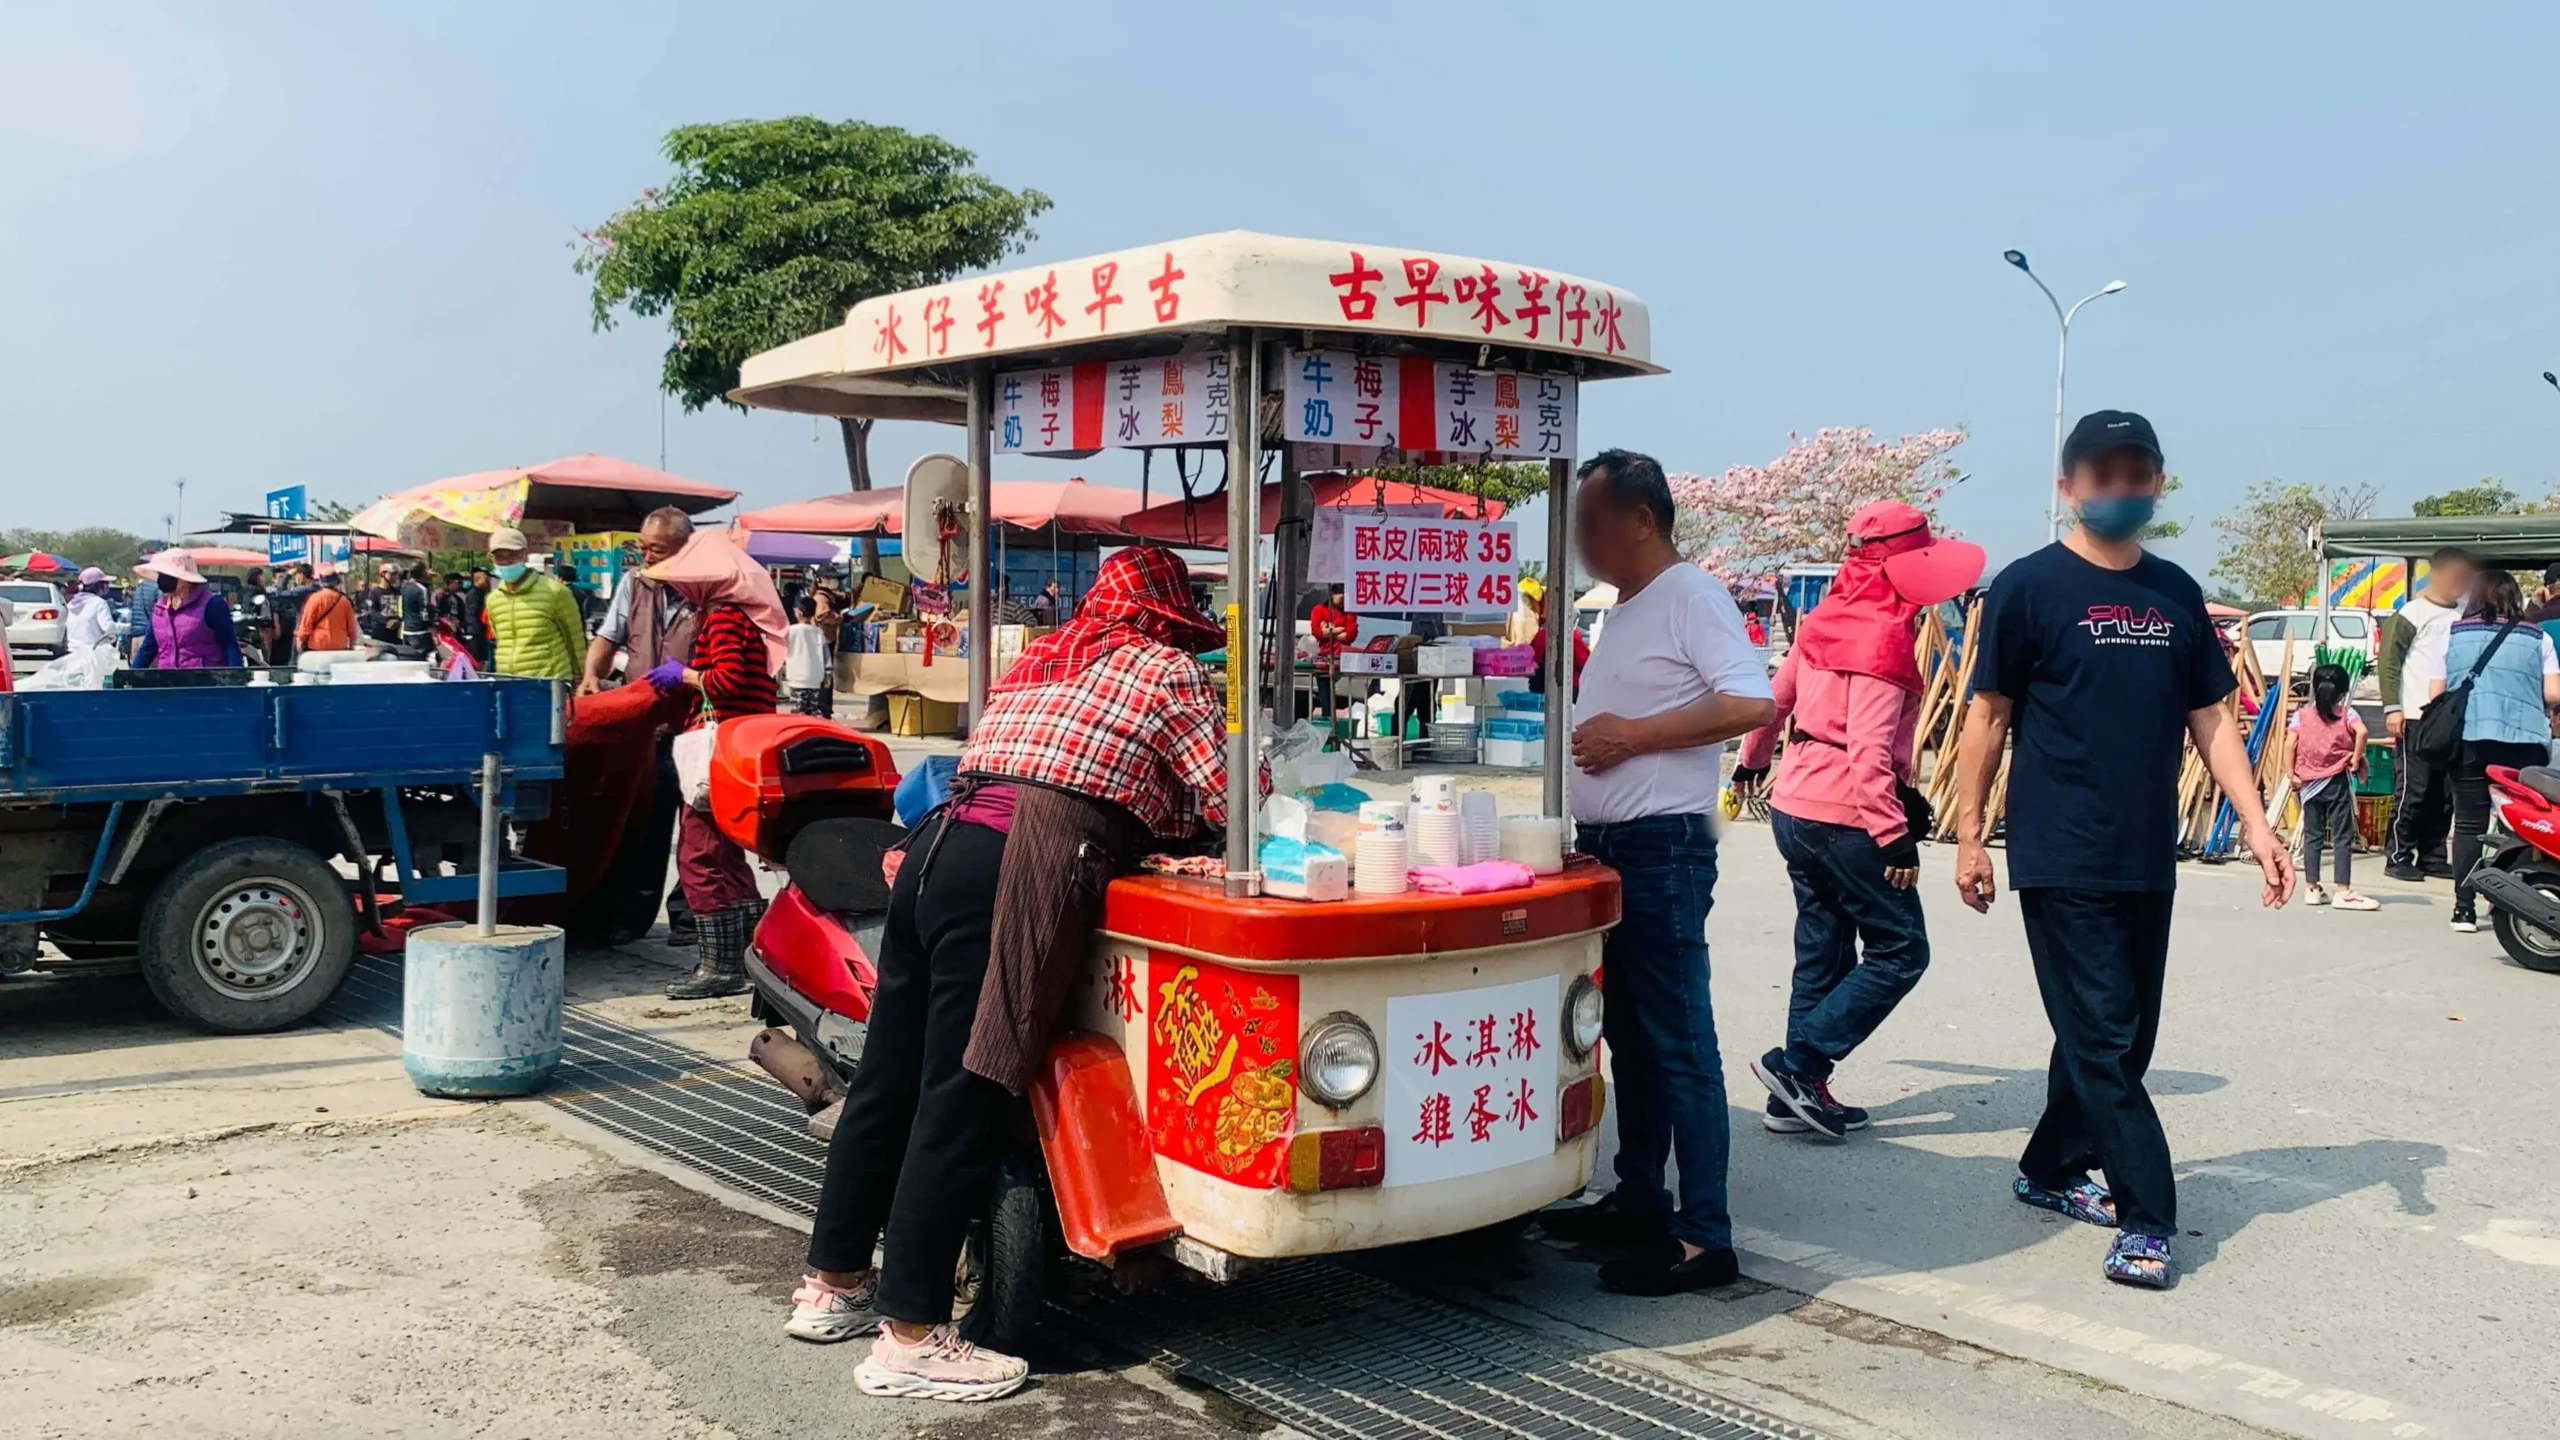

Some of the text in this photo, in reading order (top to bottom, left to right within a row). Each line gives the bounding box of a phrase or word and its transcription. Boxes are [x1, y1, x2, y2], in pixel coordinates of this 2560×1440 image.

[1329, 251, 1626, 354] 古早味芋仔冰
[1003, 376, 1023, 449] 牛奶
[1040, 373, 1061, 447] 梅子
[1118, 364, 1141, 441] 芋冰
[1161, 359, 1184, 439] 鳳梨
[1205, 354, 1229, 437] 巧克力
[1303, 355, 1334, 438] 牛奶
[1353, 360, 1384, 441] 梅子
[1449, 368, 1477, 447] 芋冰
[1494, 373, 1520, 449] 鳳梨
[1537, 376, 1562, 454] 巧克力
[1354, 526, 1469, 563] 酥皮/兩球
[1477, 532, 1512, 563] 35
[1355, 570, 1512, 607] 酥皮/三球 45
[2081, 605, 2172, 636] FILA
[2094, 637, 2170, 647] AUTHENTIC SPORTS
[1413, 1007, 1542, 1077] 冰淇淋
[1412, 1077, 1539, 1149] 雞蛋冰
